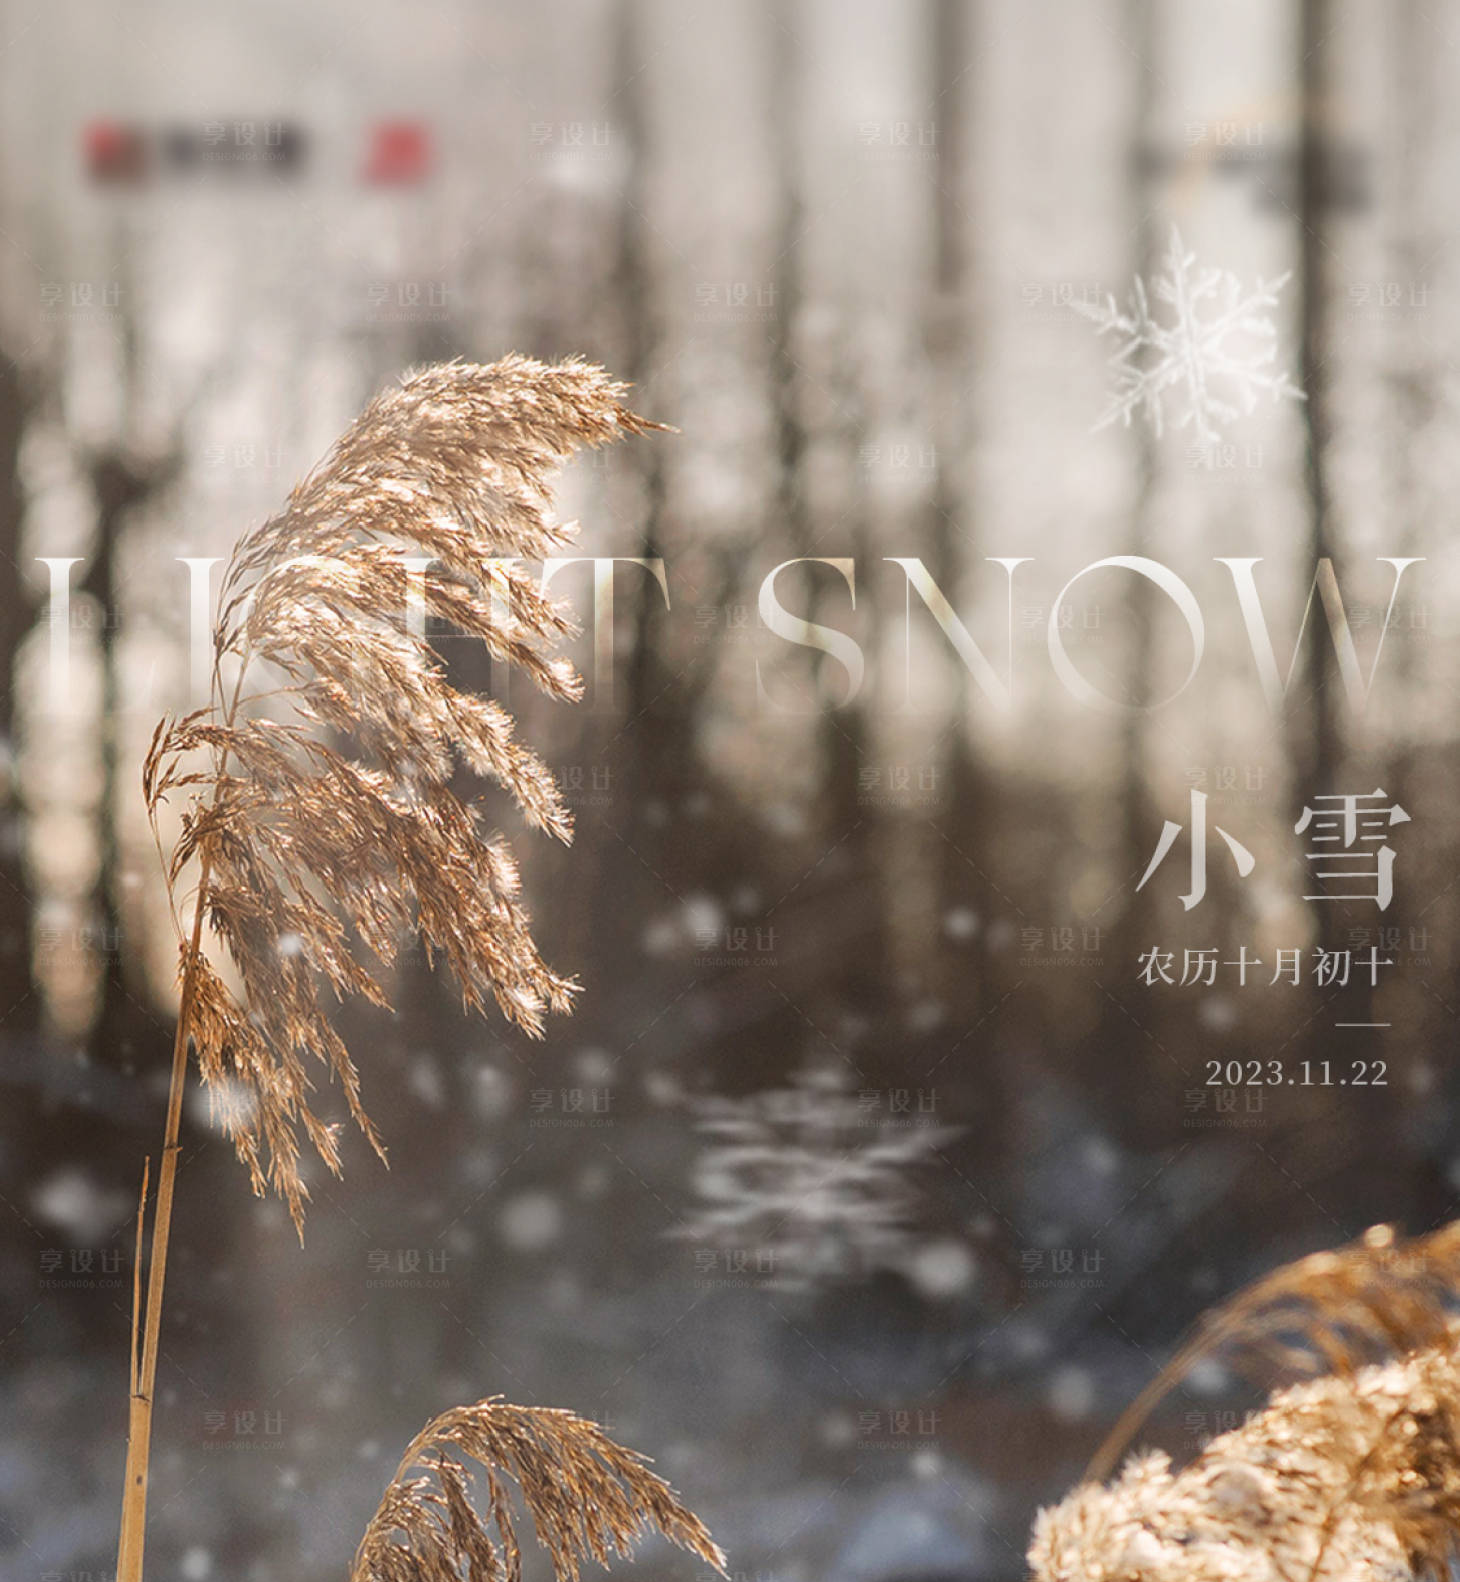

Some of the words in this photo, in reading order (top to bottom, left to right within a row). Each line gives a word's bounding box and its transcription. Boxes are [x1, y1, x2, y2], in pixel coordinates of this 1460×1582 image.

[755, 555, 1428, 714] SNOW
[1136, 787, 1412, 912] 小雪
[1136, 946, 1394, 987] 农历十月初十
[1204, 1060, 1389, 1086] 2023.11.22
